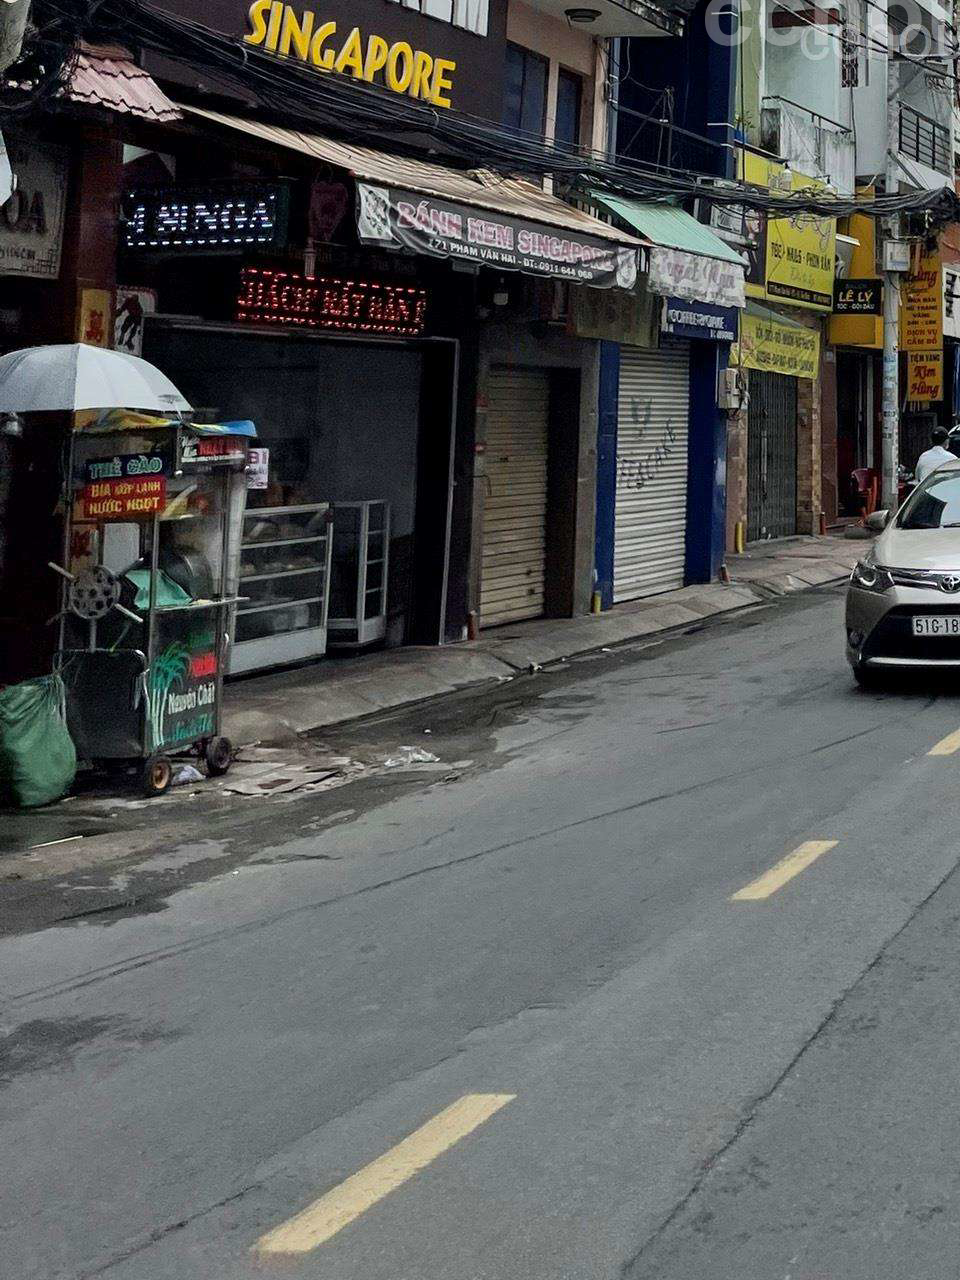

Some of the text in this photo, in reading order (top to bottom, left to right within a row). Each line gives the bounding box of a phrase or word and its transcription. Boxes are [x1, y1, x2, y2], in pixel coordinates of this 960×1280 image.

[244, 0, 457, 109] SINGAPORE
[397, 200, 463, 240] BÁNH
[467, 217, 515, 251] KEM
[427, 237, 448, 251] 171
[501, 254, 516, 265] HAI
[539, 261, 559, 273] 0911
